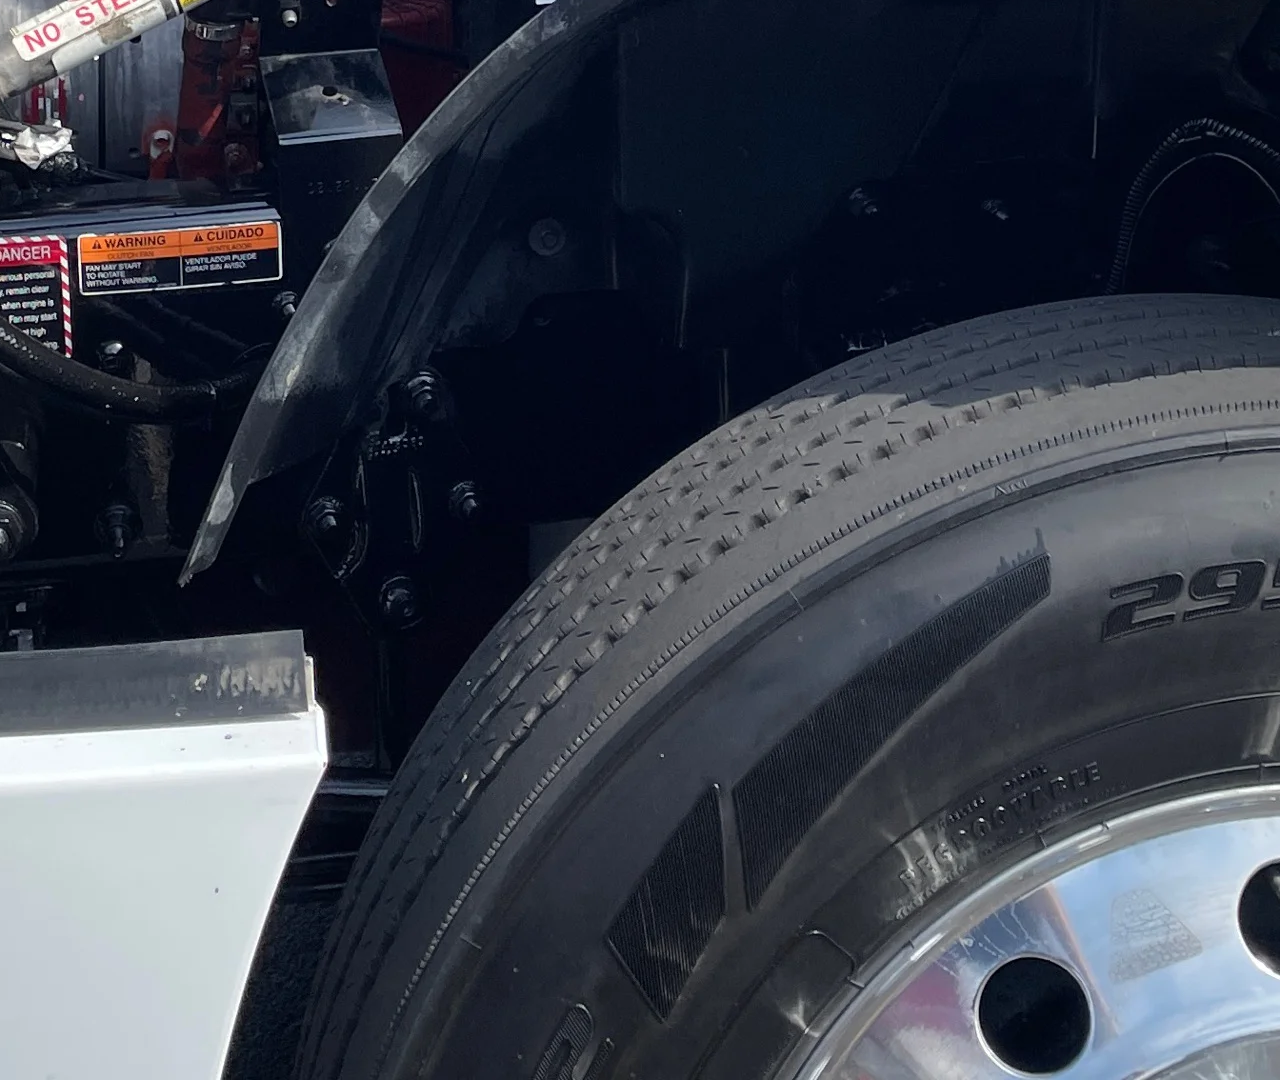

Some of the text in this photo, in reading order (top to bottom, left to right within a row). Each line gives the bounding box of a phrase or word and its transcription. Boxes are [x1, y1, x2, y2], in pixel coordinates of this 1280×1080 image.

[22, 22, 61, 52] NO
[105, 227, 264, 249] WARNING CUIDADO
[107, 251, 138, 260] CLUTCH
[207, 242, 252, 252] VENTILADOR
[185, 252, 257, 265] VENTILADOR PUEDE
[85, 262, 141, 272] FAN MAY START
[185, 264, 208, 273] GIRAR
[210, 263, 222, 271] SIN
[24, 270, 55, 281] personal
[86, 270, 125, 280] TO ROTATE
[86, 278, 120, 288] WITHOUT
[121, 276, 159, 286] WARNING.
[6, 286, 30, 296] remain
[31, 285, 49, 294] clear
[1, 301, 20, 310] when
[22, 299, 46, 310] engine
[47, 298, 54, 307] is
[8, 312, 57, 324] Fan may start
[30, 327, 46, 337] high
